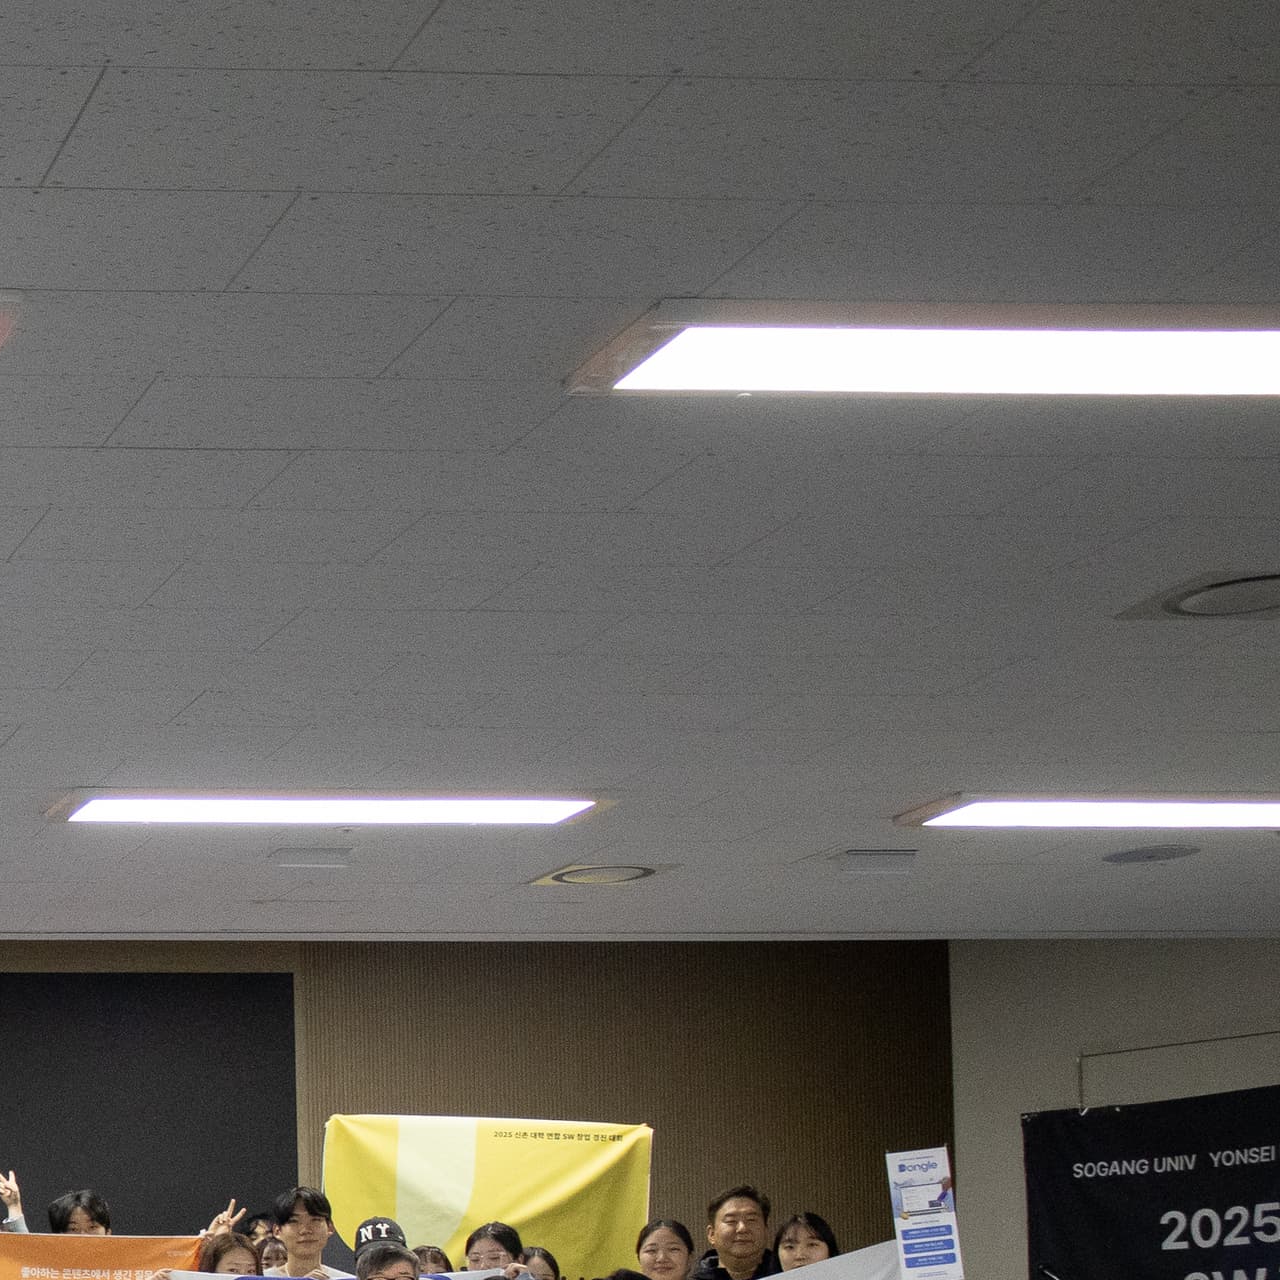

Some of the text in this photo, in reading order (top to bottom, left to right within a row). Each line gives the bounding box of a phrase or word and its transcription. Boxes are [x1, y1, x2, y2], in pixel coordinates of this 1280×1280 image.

[562, 1132, 575, 1140] SW
[1072, 1145, 1276, 1178] SOGANG UNIV YONSEI
[358, 1222, 392, 1243] NY
[1159, 1201, 1280, 1250] 2025
[20, 1267, 60, 1280] 좋아하는
[62, 1267, 110, 1280] 콘텐츠에서
